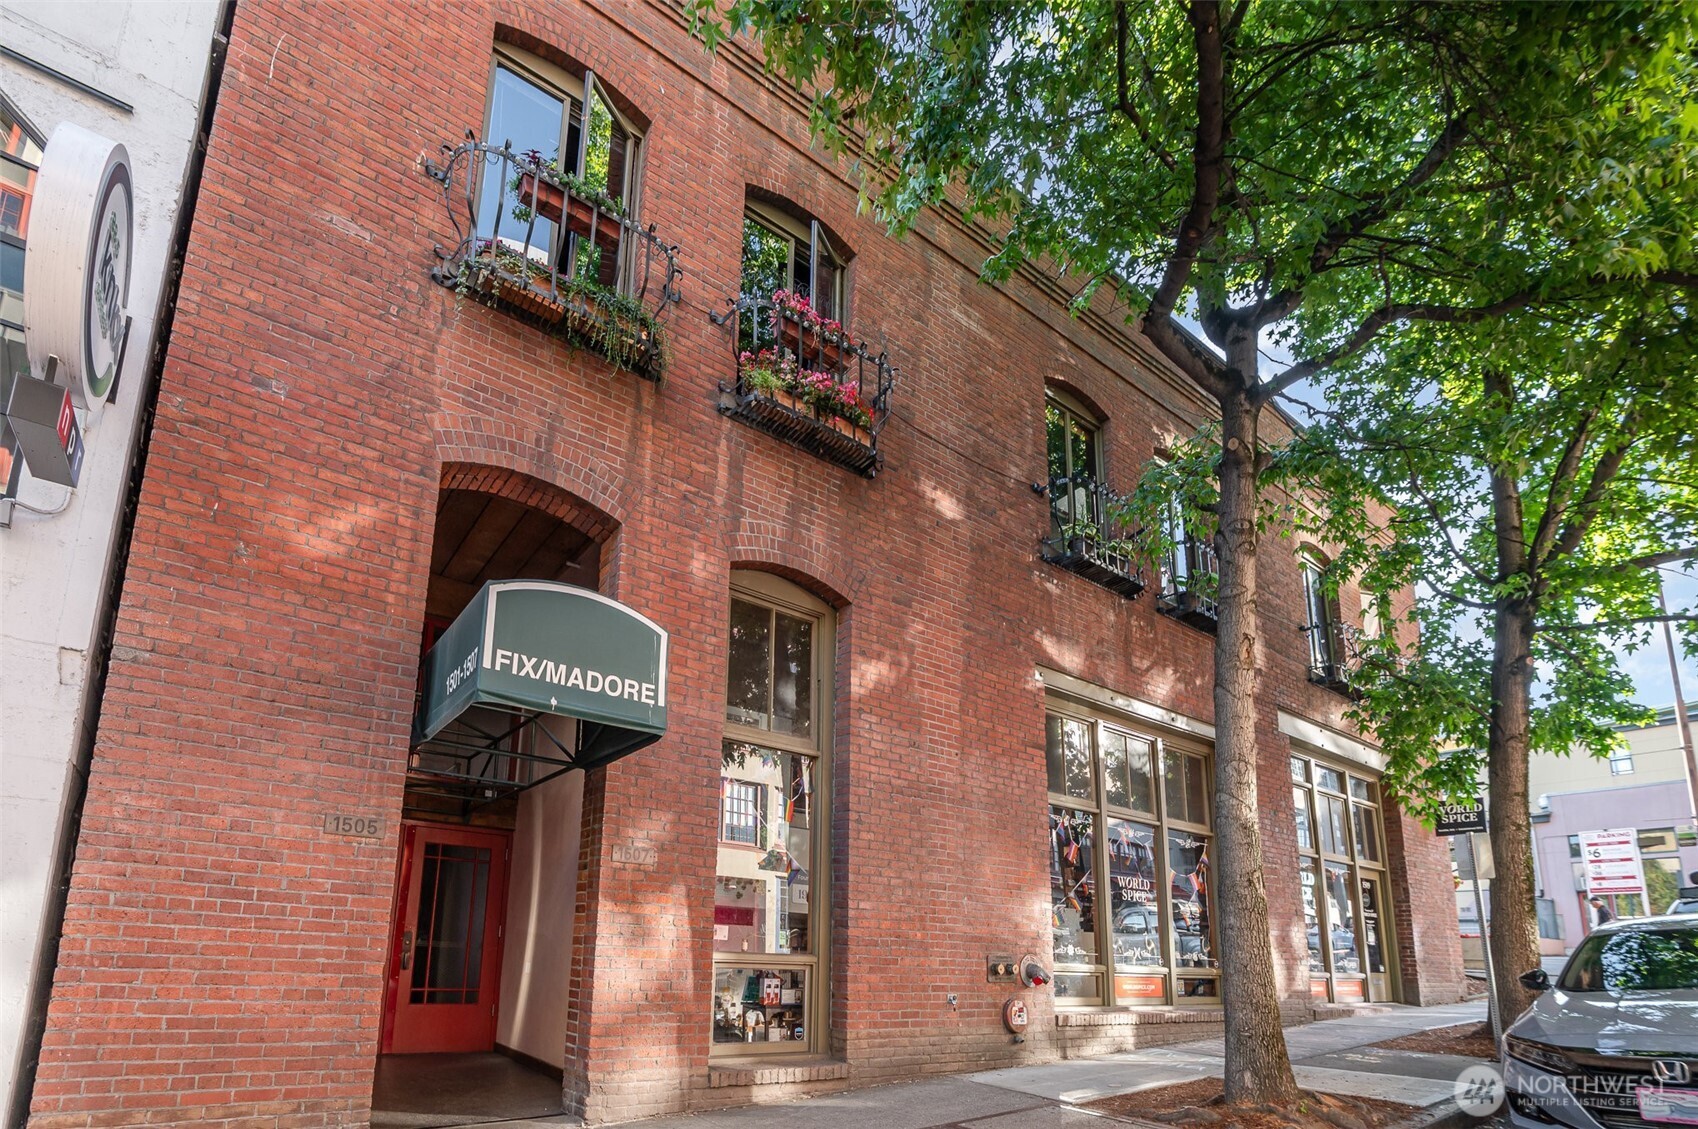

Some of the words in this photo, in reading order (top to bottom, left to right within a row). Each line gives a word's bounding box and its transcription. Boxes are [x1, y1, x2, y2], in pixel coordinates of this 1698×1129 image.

[61, 405, 82, 470] npr
[446, 646, 480, 695] 1501-1507
[494, 648, 656, 706] FIX/MADORE
[333, 816, 378, 835] 1505
[1441, 812, 1478, 824] SPICE
[1588, 848, 1601, 858] $6
[1117, 876, 1150, 890] WORLD
[1122, 889, 1148, 902] SPICE
